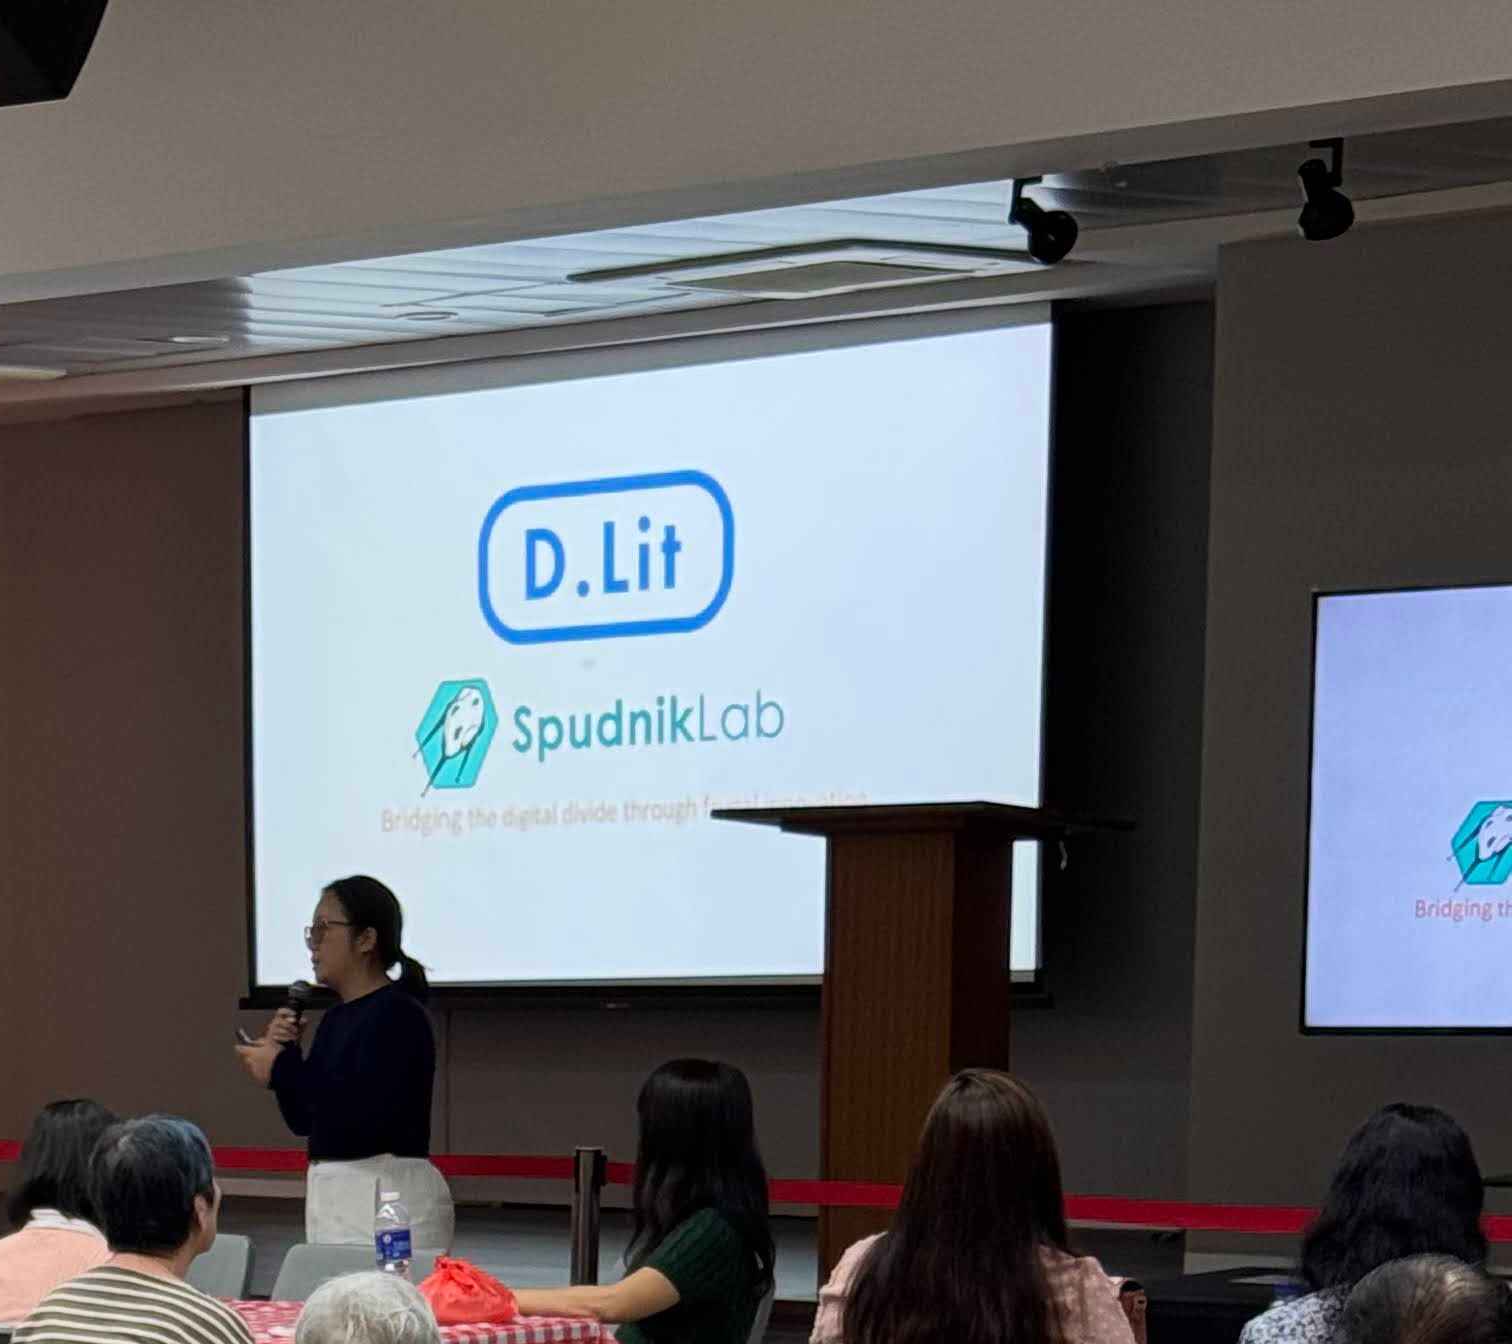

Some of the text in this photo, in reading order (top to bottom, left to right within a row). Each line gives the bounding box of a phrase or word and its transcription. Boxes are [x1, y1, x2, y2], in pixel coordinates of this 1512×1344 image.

[525, 515, 682, 601] D.Lit
[512, 689, 786, 762] SpudnikLab
[382, 807, 462, 838] Bridging
[469, 805, 497, 829] the
[502, 802, 559, 830] digital
[562, 800, 620, 826] divide
[624, 798, 697, 827] through
[1415, 898, 1512, 922] Bridging th
